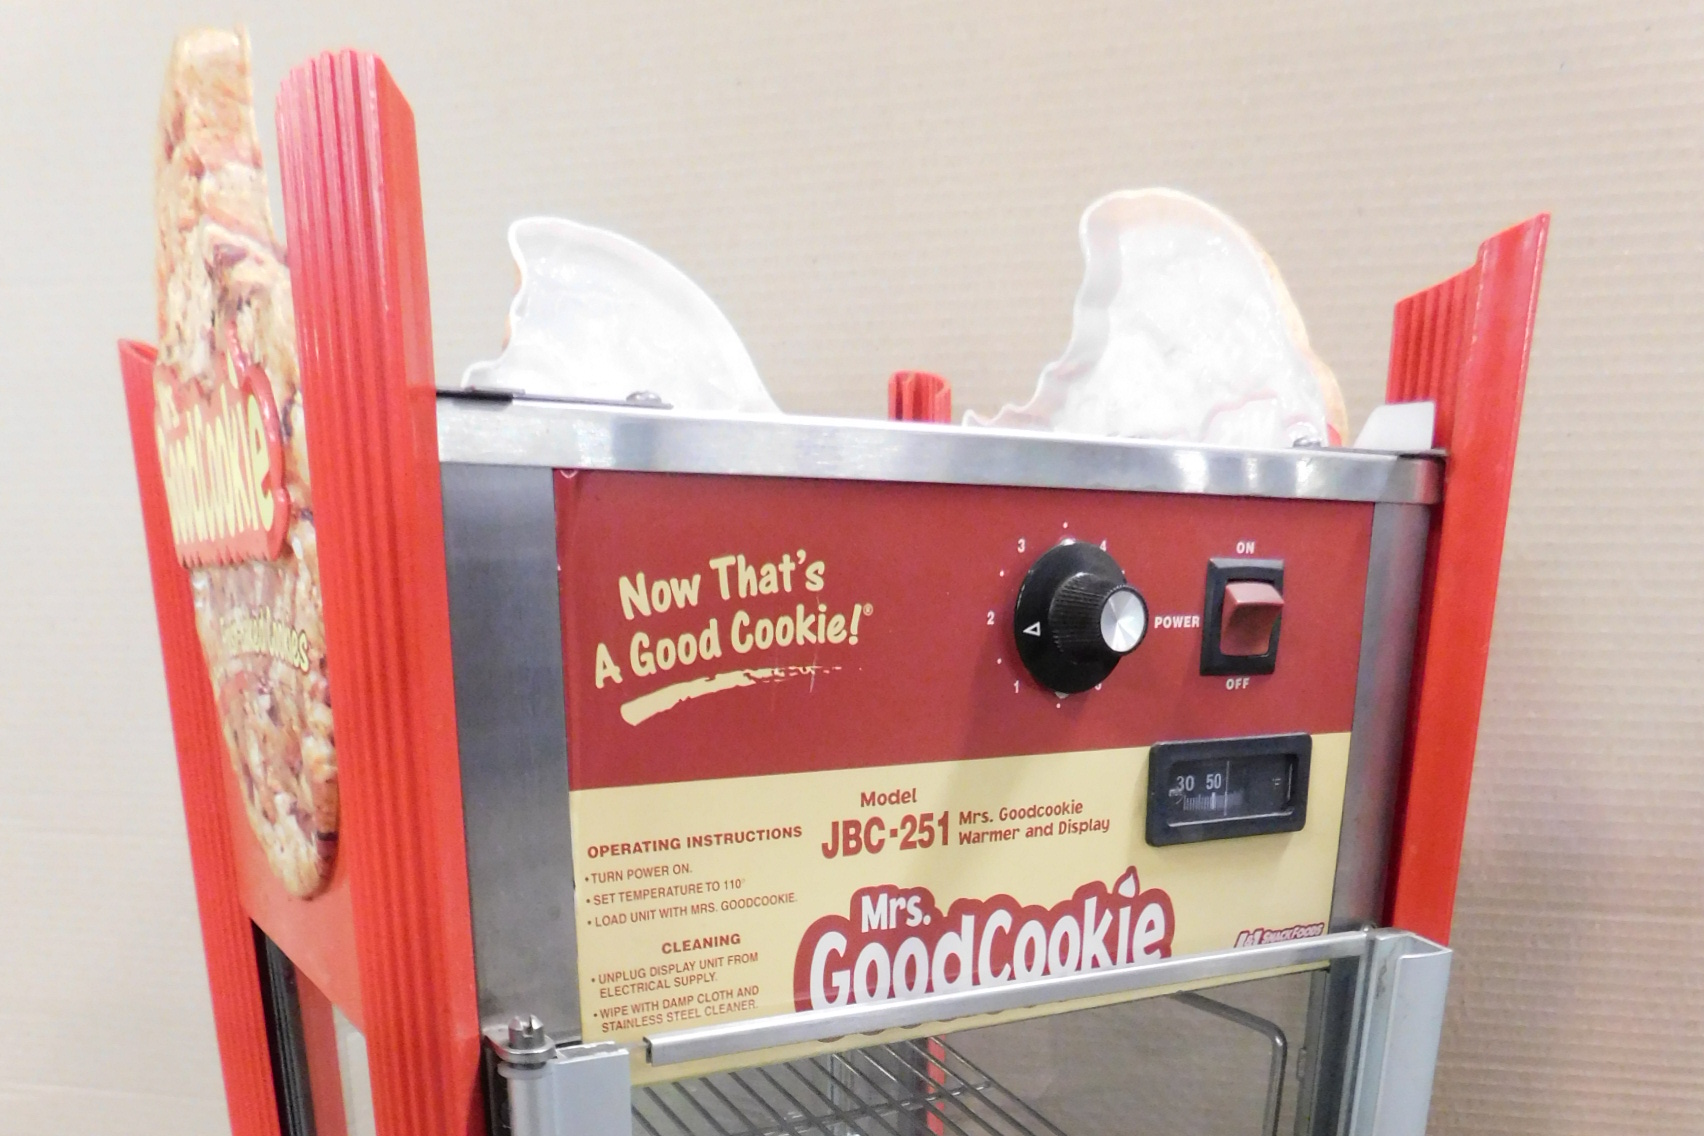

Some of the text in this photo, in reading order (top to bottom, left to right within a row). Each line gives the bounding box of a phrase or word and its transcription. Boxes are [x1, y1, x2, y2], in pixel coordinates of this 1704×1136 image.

[1018, 539, 1026, 553] 3
[1236, 541, 1255, 554] ON
[618, 549, 826, 620] Now That's
[986, 611, 995, 625] 2
[1154, 615, 1201, 629] POWER
[595, 642, 623, 689] A
[629, 618, 722, 677] Good
[1013, 680, 1020, 694] 1
[1225, 678, 1250, 690] OFF
[1176, 773, 1222, 792] 30 50
[860, 788, 917, 808] Model
[958, 799, 1083, 825] Mrs. Goodcookie
[587, 826, 803, 859] OPERATING INSTRUCTIONS
[821, 810, 950, 859] JBC-251
[958, 817, 1110, 845] Warmer and Display
[591, 863, 693, 884] TURN POWER ON.
[593, 893, 616, 906] SET
[618, 883, 704, 902] TEMPERATURE
[705, 881, 720, 893] TO
[595, 892, 798, 927] LOAD UNIT WITH MRS. GOODCOOKIE.
[861, 892, 931, 933] Mrs.
[661, 933, 741, 955] CLEANING
[809, 873, 1166, 1011] GoodCookie
[598, 951, 758, 985] UNPLUG DISPLAY UNIT FROM
[600, 972, 718, 999] ELECTRICAL SUPPLY.
[600, 984, 760, 1019] WIPE WITH DAMP CLOTH AND
[602, 999, 758, 1034] STAINLESS STEEL CLEANER.
